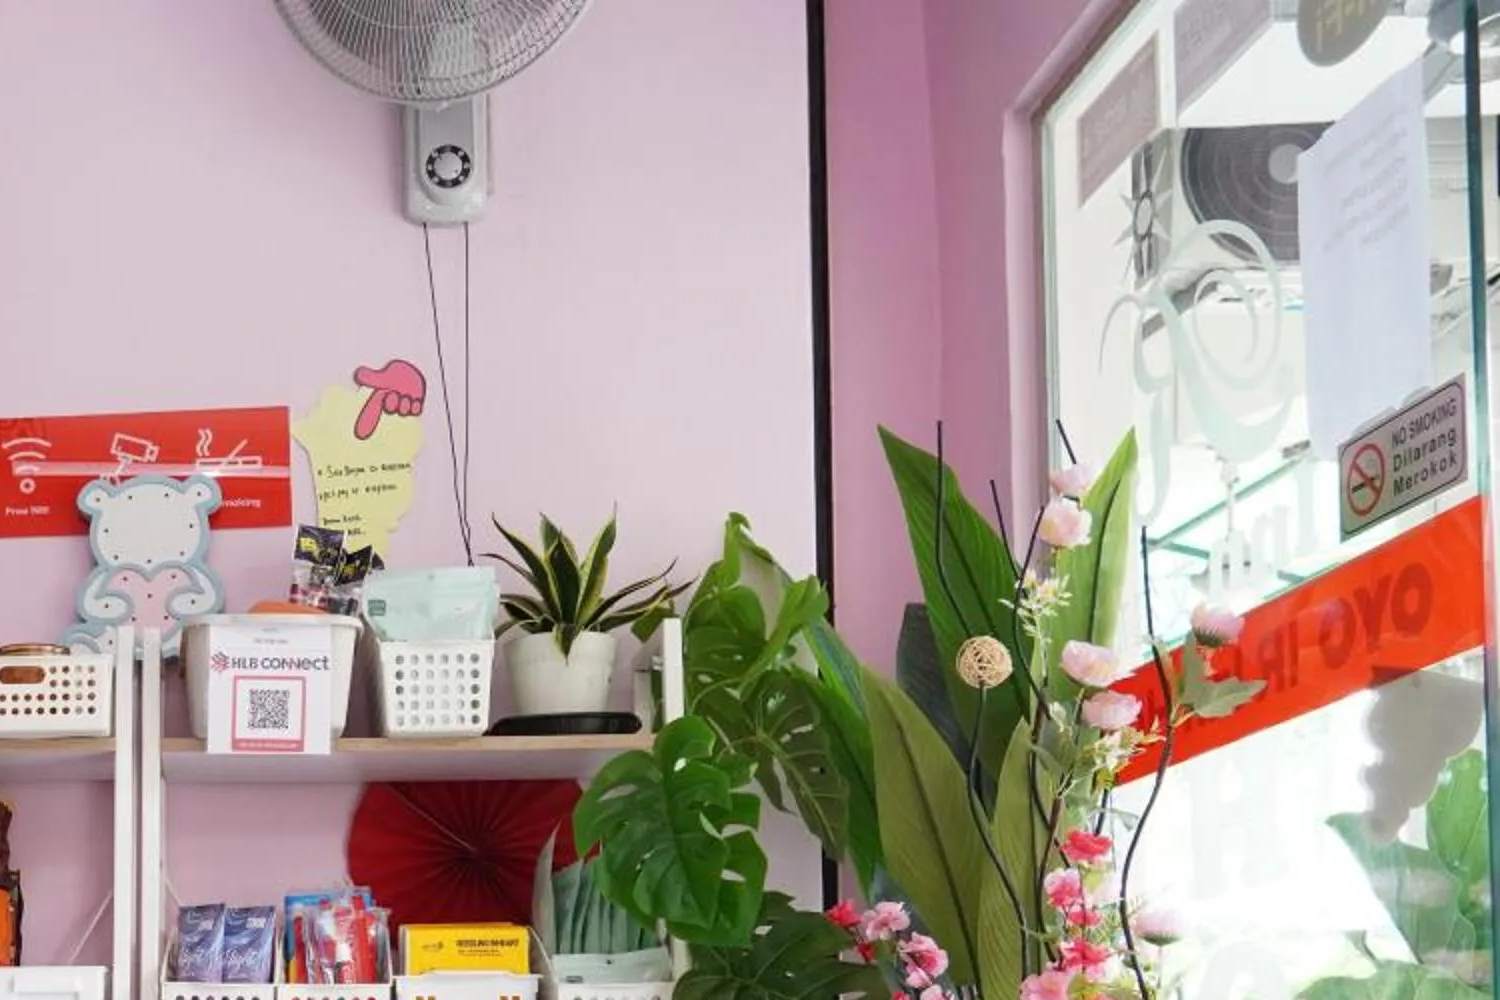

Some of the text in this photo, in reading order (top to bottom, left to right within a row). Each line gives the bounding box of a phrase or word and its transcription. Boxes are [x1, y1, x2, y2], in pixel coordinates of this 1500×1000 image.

[1393, 428, 1457, 473] Dilarang
[1393, 451, 1458, 497] Merokok
[222, 497, 261, 508] moking
[231, 656, 258, 670] HLB
